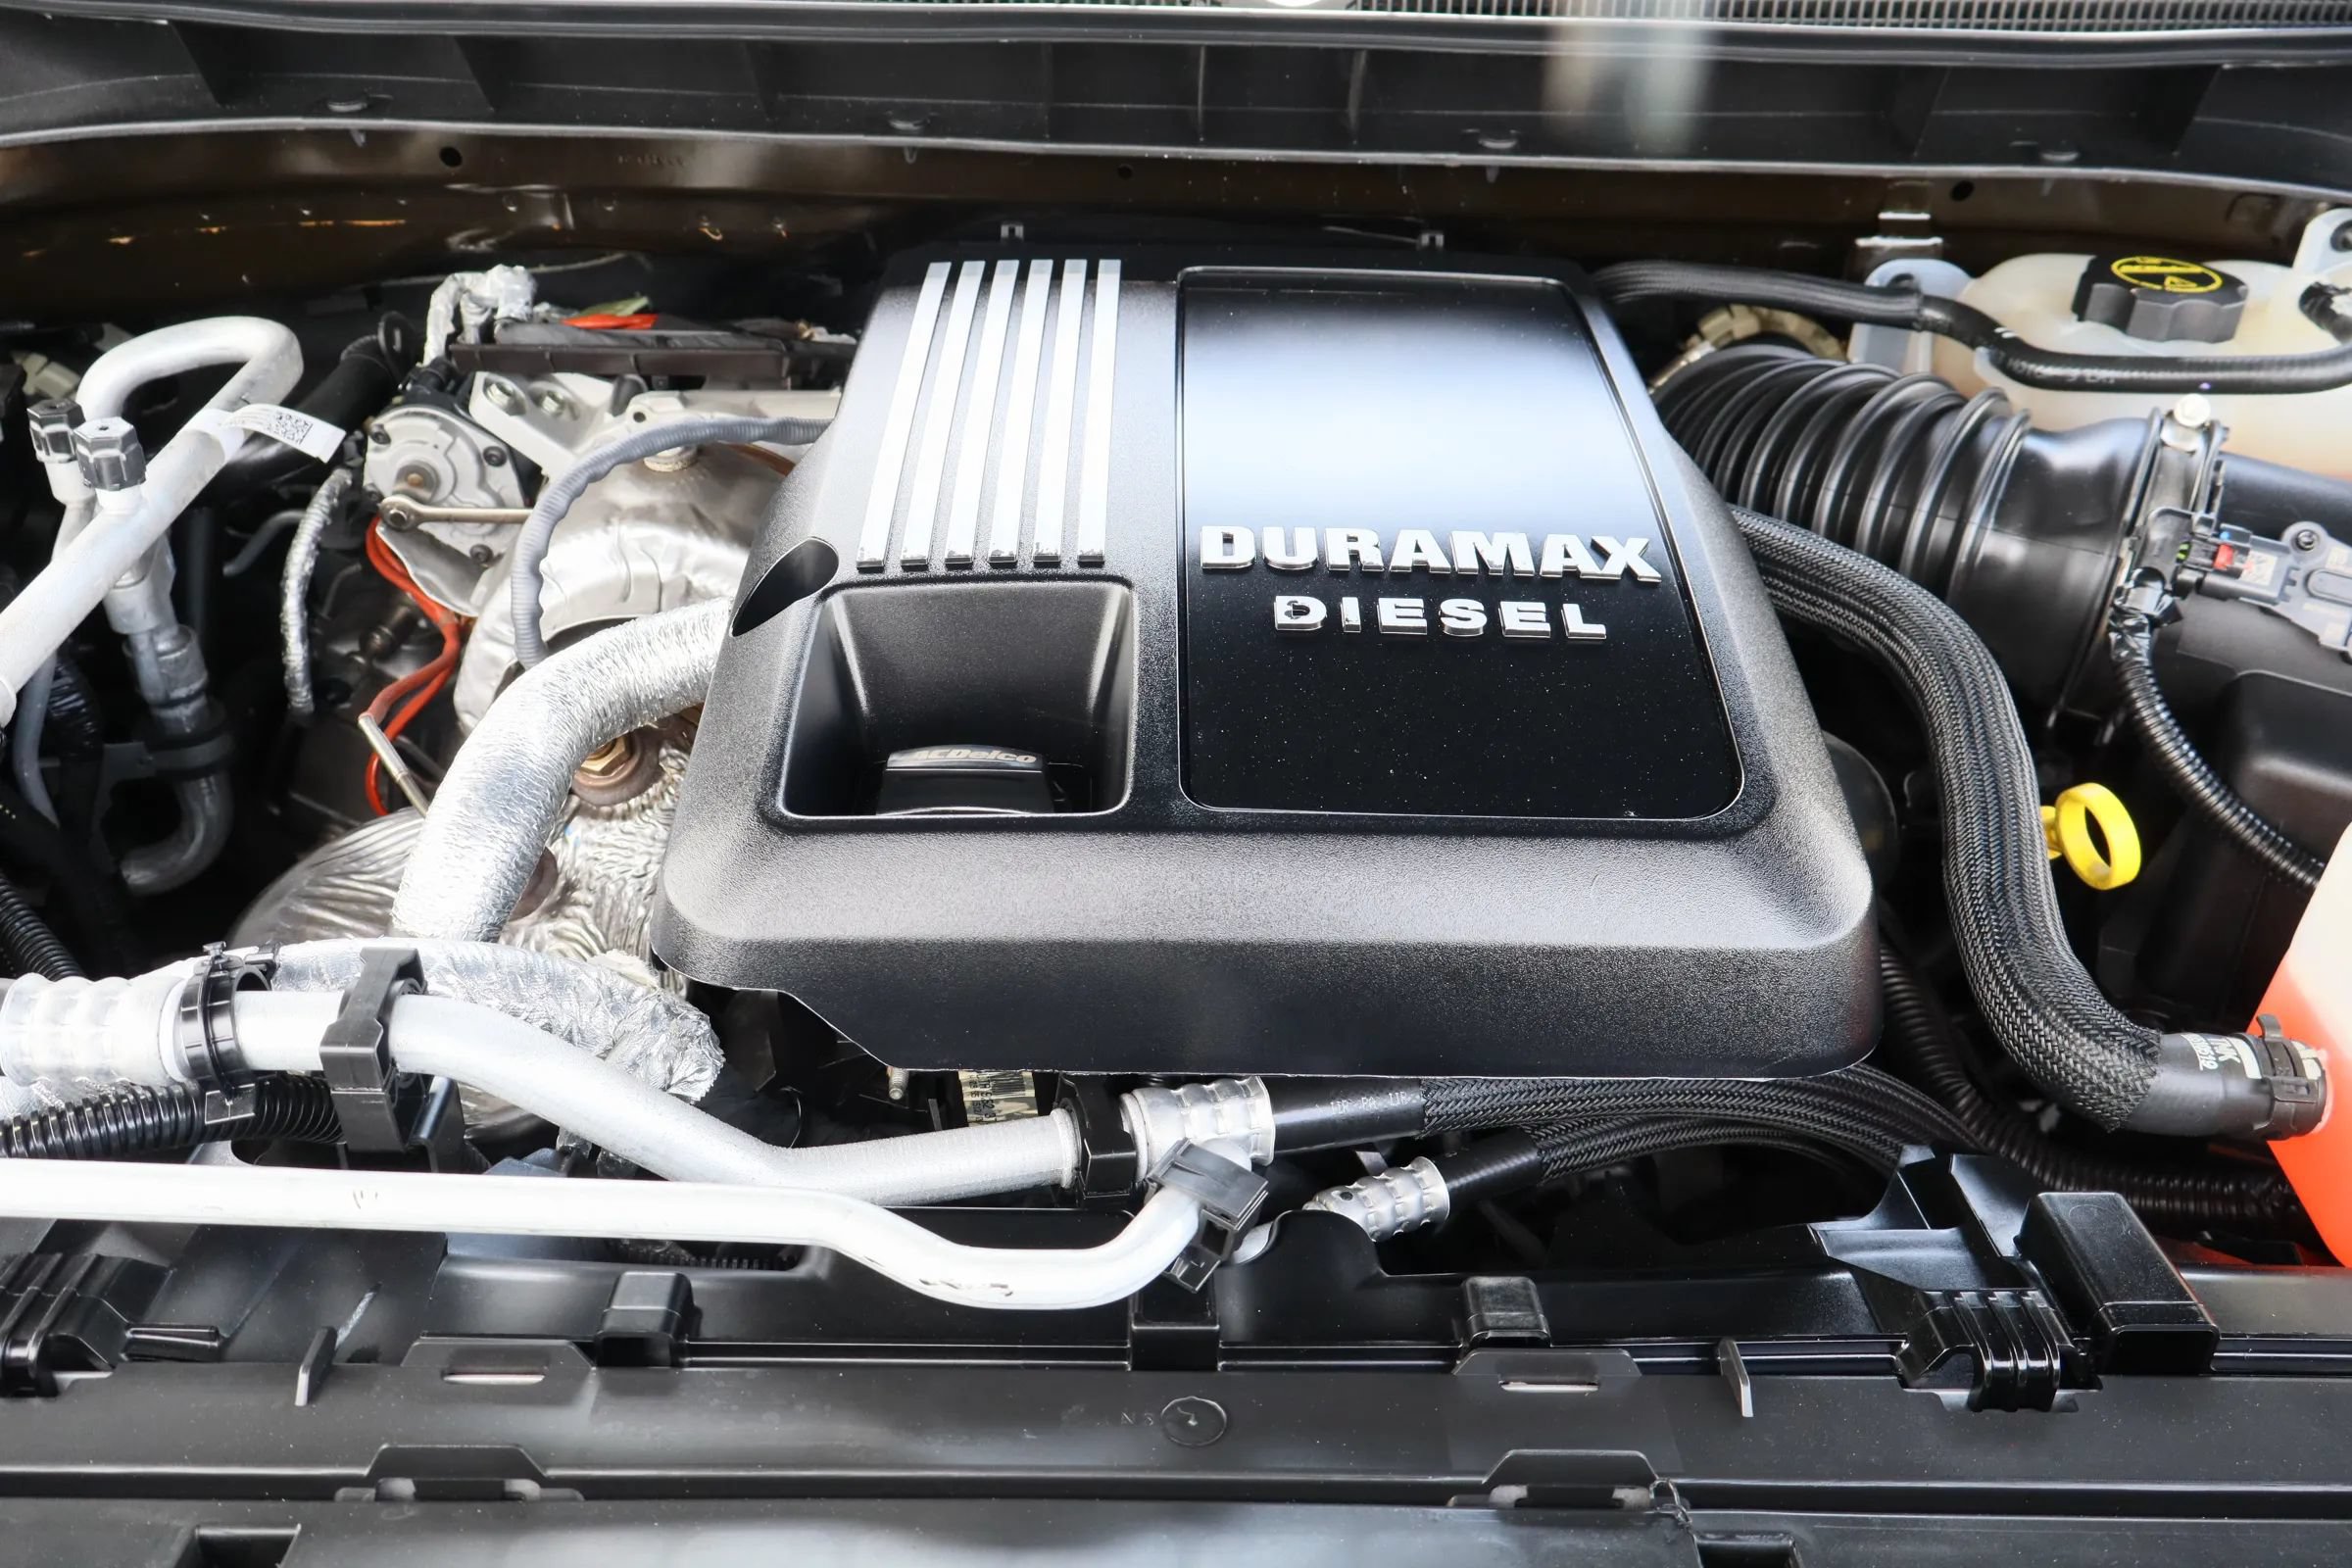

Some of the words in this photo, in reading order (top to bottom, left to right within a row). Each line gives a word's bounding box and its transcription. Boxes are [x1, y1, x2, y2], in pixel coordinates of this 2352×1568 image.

[1200, 525, 1662, 582] DURAMAX
[1274, 595, 1607, 639] DIESEL
[911, 748, 1037, 764] ACDelco
